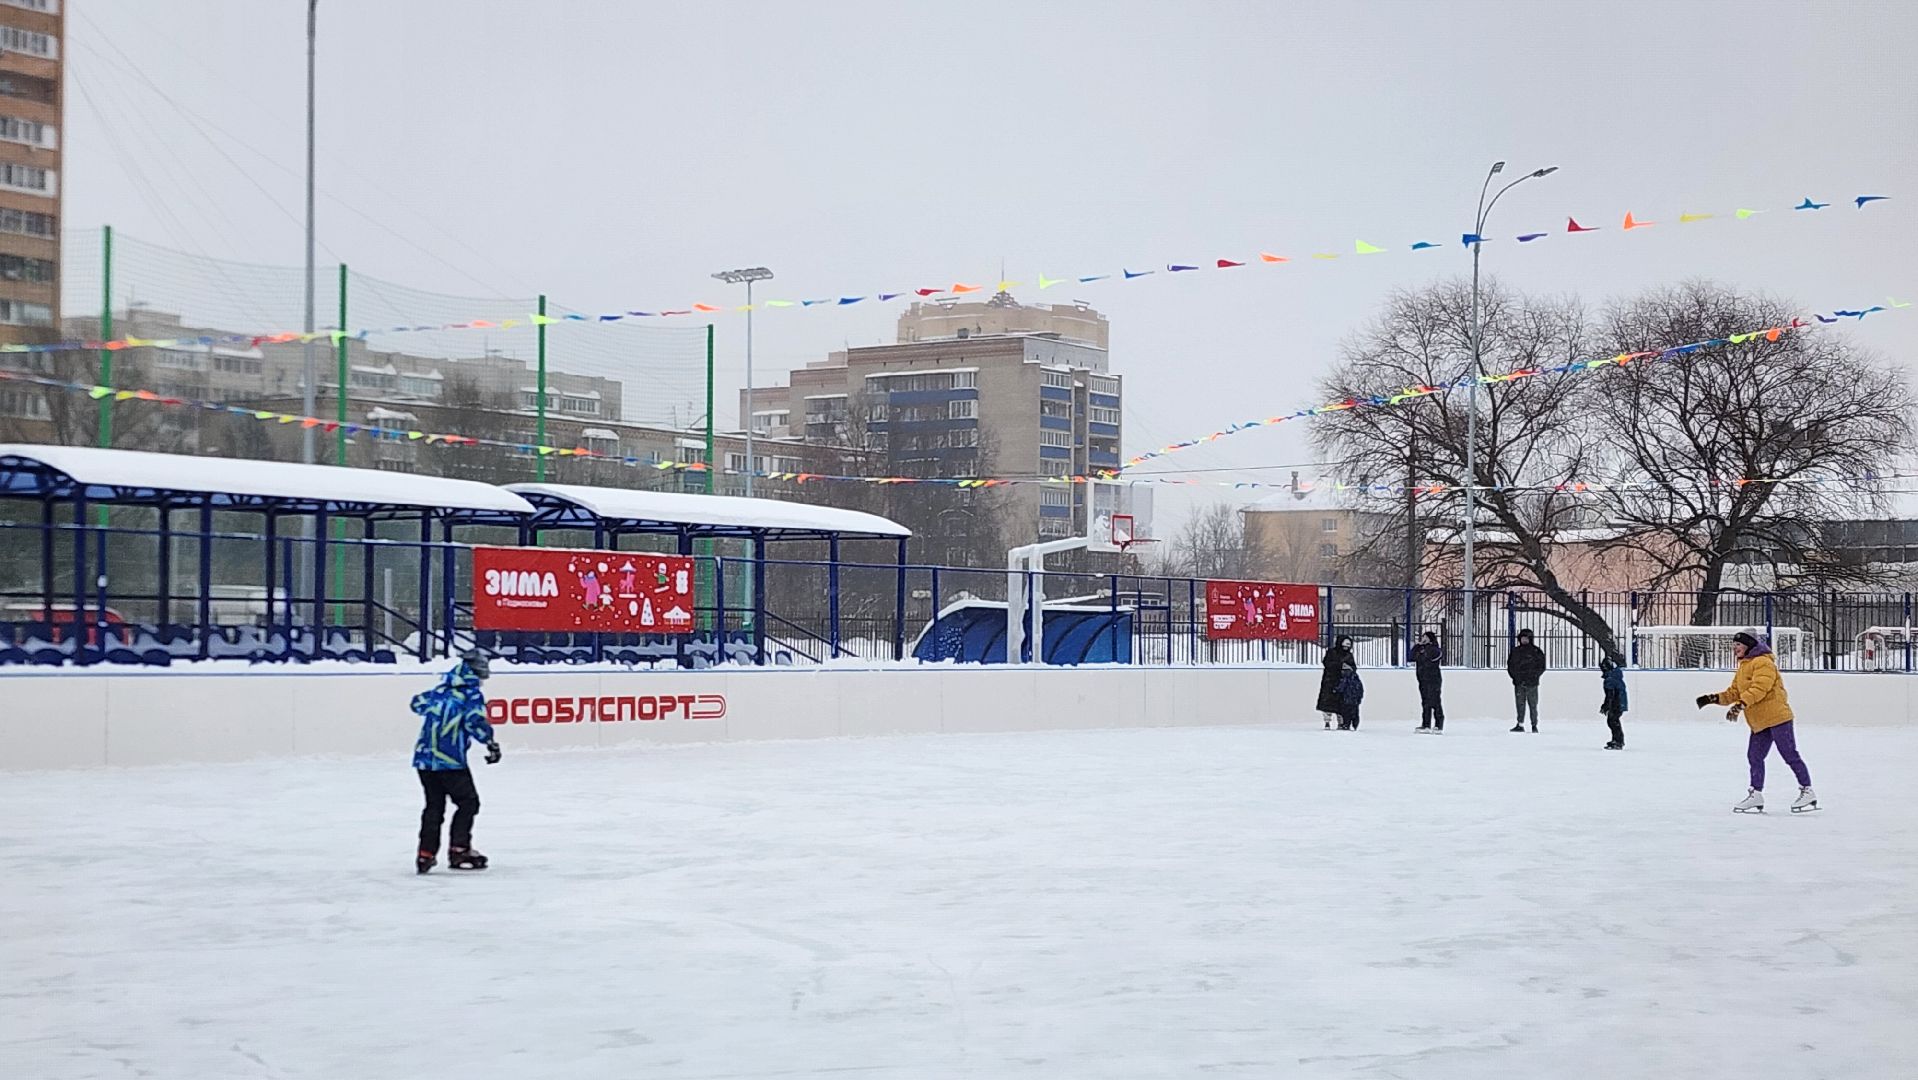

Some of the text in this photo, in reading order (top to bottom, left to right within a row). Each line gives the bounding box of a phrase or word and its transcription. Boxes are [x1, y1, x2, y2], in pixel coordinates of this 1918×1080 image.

[485, 569, 558, 597] ЗИМА
[1289, 603, 1315, 617] ЗИМА
[486, 695, 696, 724] ОСОБЛСПОРТ
